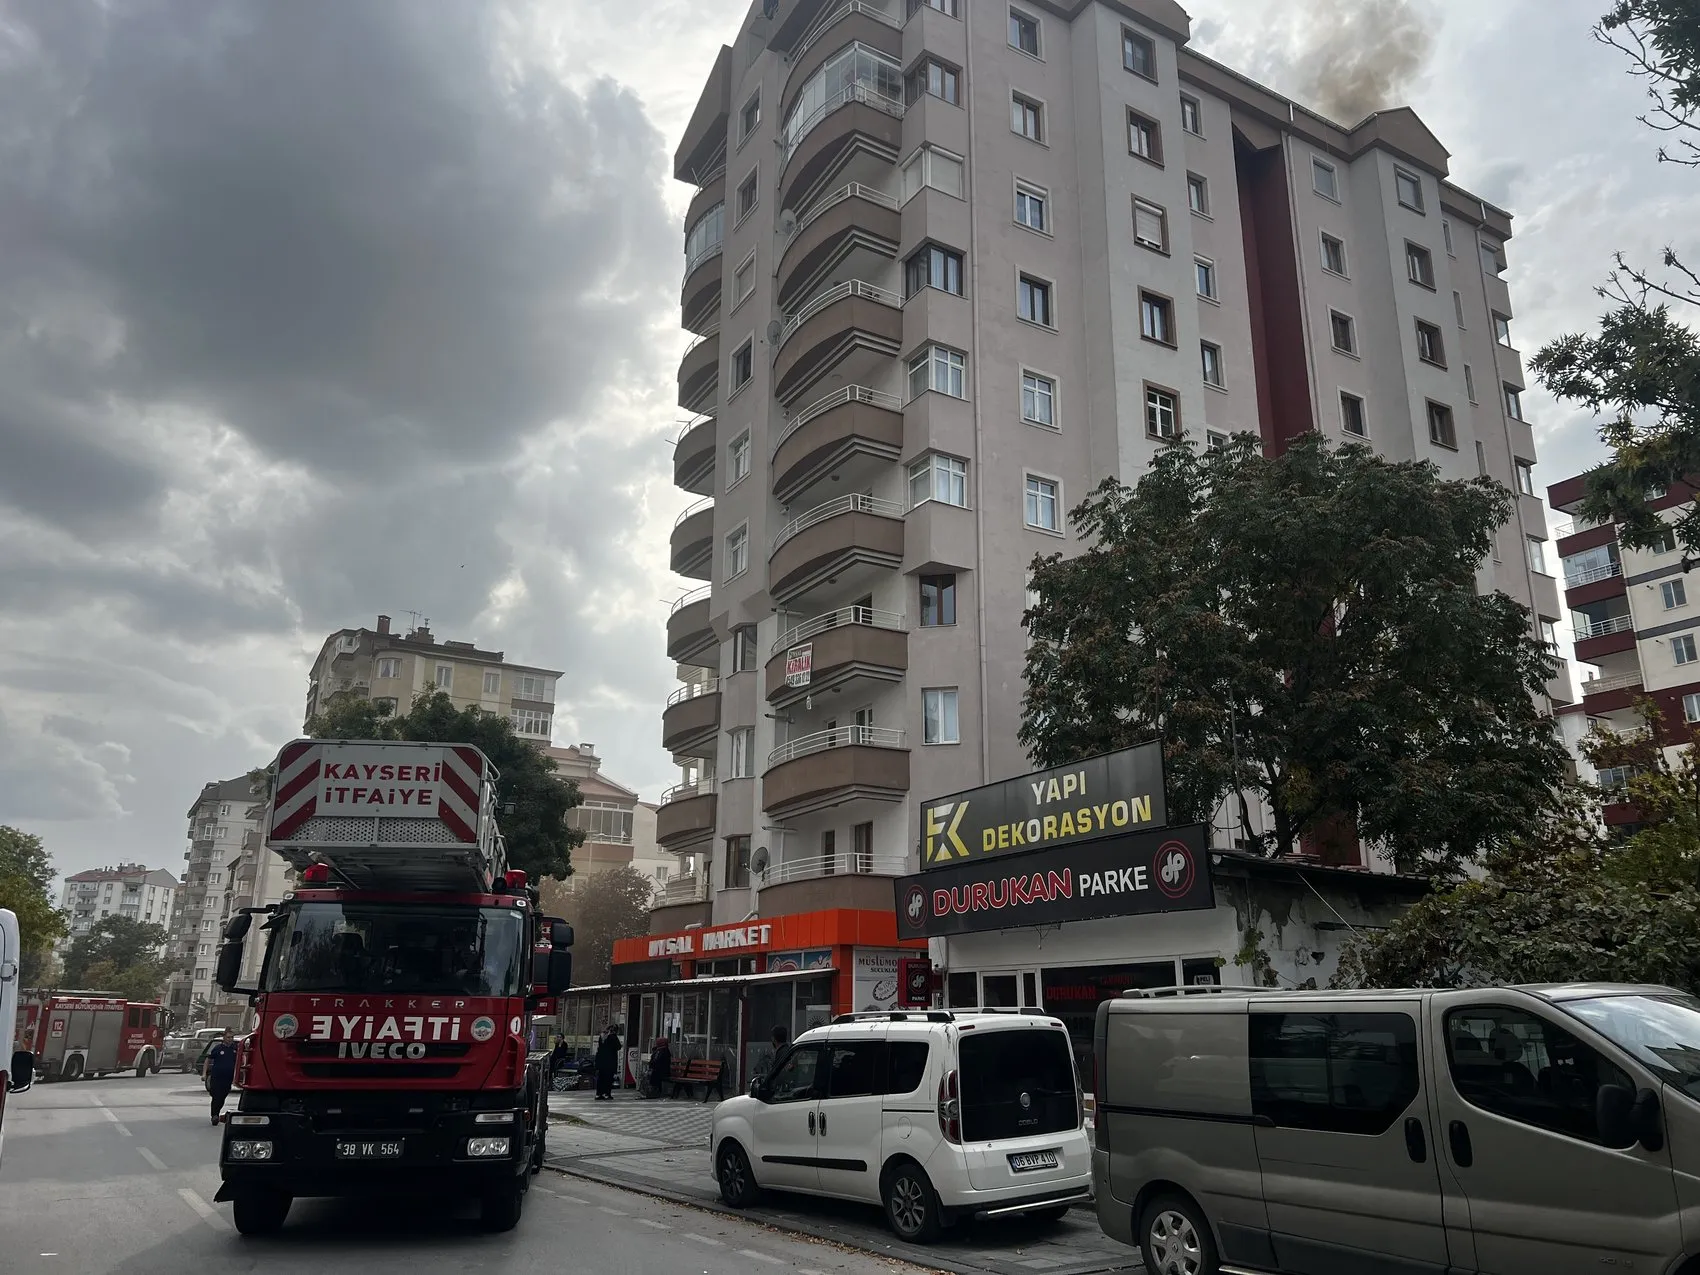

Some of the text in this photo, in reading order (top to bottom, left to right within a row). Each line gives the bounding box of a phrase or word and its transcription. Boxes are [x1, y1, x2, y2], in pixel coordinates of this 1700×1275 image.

[324, 763, 441, 782] KAYSERİ
[325, 787, 433, 805] İTFAİYE
[1031, 771, 1086, 805] YAPI
[982, 795, 1152, 852] DEKORASYON
[933, 866, 1149, 917] DURUKAN PARKE
[702, 924, 772, 951] MARKET
[859, 955, 898, 967] MÜSLÜMO
[310, 998, 465, 1009] TRAKKER
[54, 1021, 63, 1030] 112
[338, 1042, 426, 1059] IVECO
[343, 1143, 399, 1155] 38 VK 564
